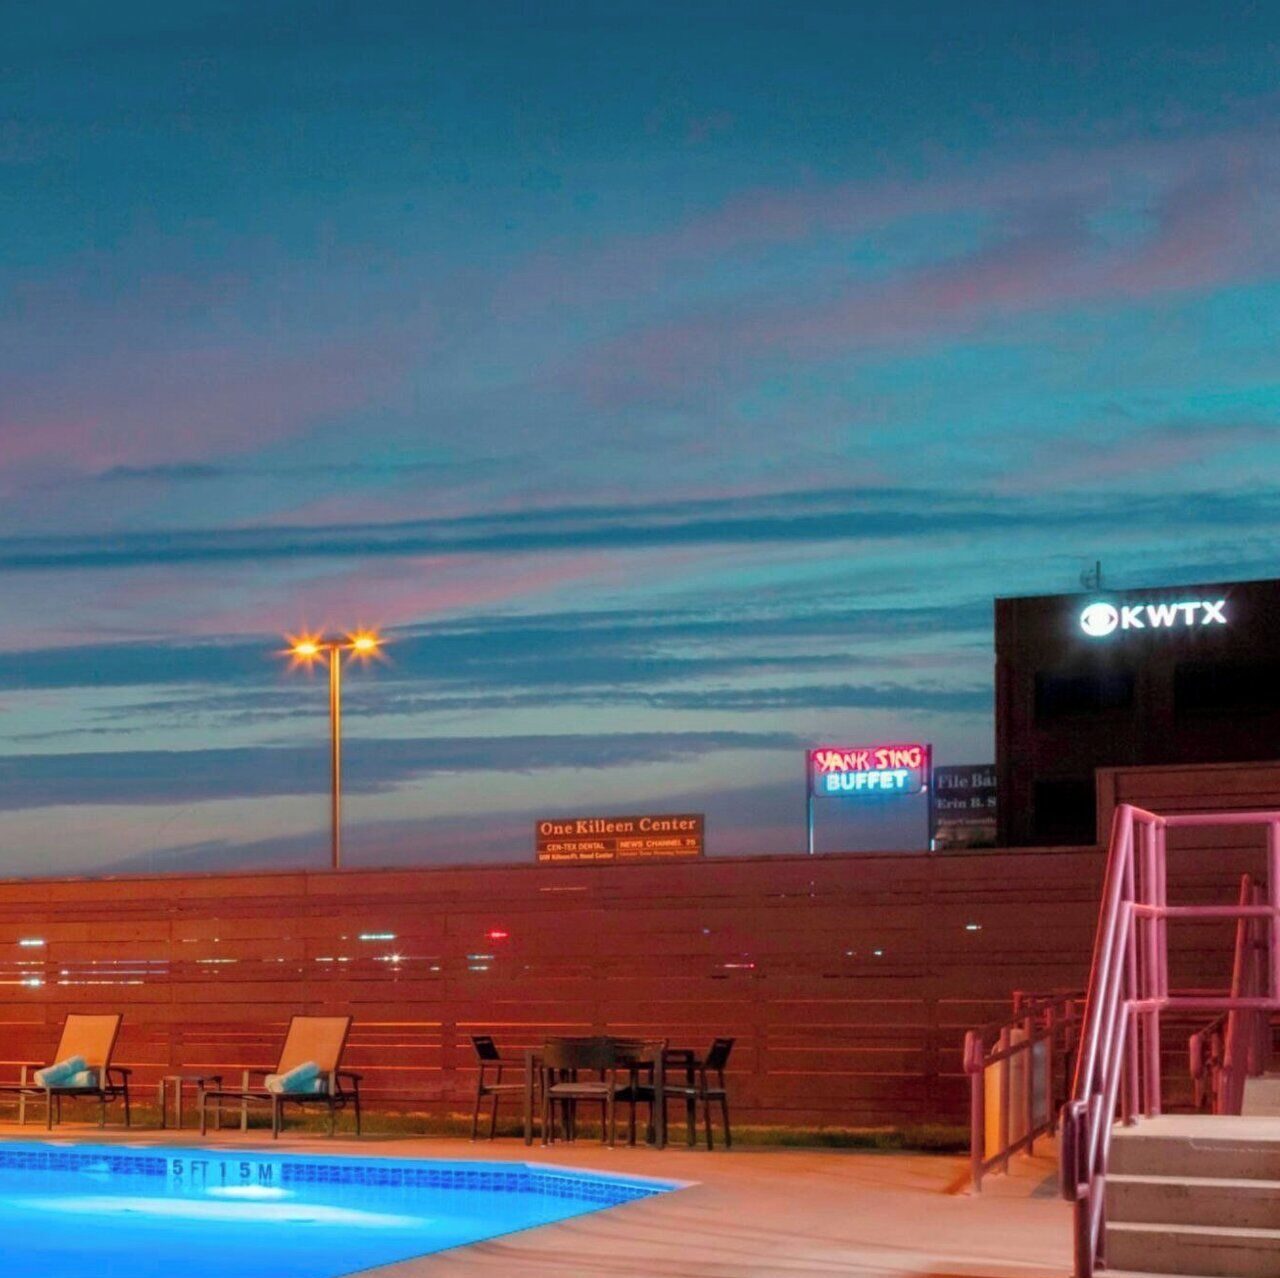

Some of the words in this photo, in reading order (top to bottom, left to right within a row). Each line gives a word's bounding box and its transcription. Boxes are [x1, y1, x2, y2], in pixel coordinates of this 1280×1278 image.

[1121, 600, 1228, 629] KWTX
[816, 750, 870, 772] YANK
[874, 748, 921, 769] SING
[826, 769, 908, 791] BUFFET
[540, 822, 572, 835] One
[576, 819, 633, 834] Killeen
[639, 817, 697, 831] Center
[578, 842, 605, 850] DENTAL
[619, 840, 643, 848] NEWS
[172, 1159, 184, 1175] 5
[191, 1161, 209, 1178] FT
